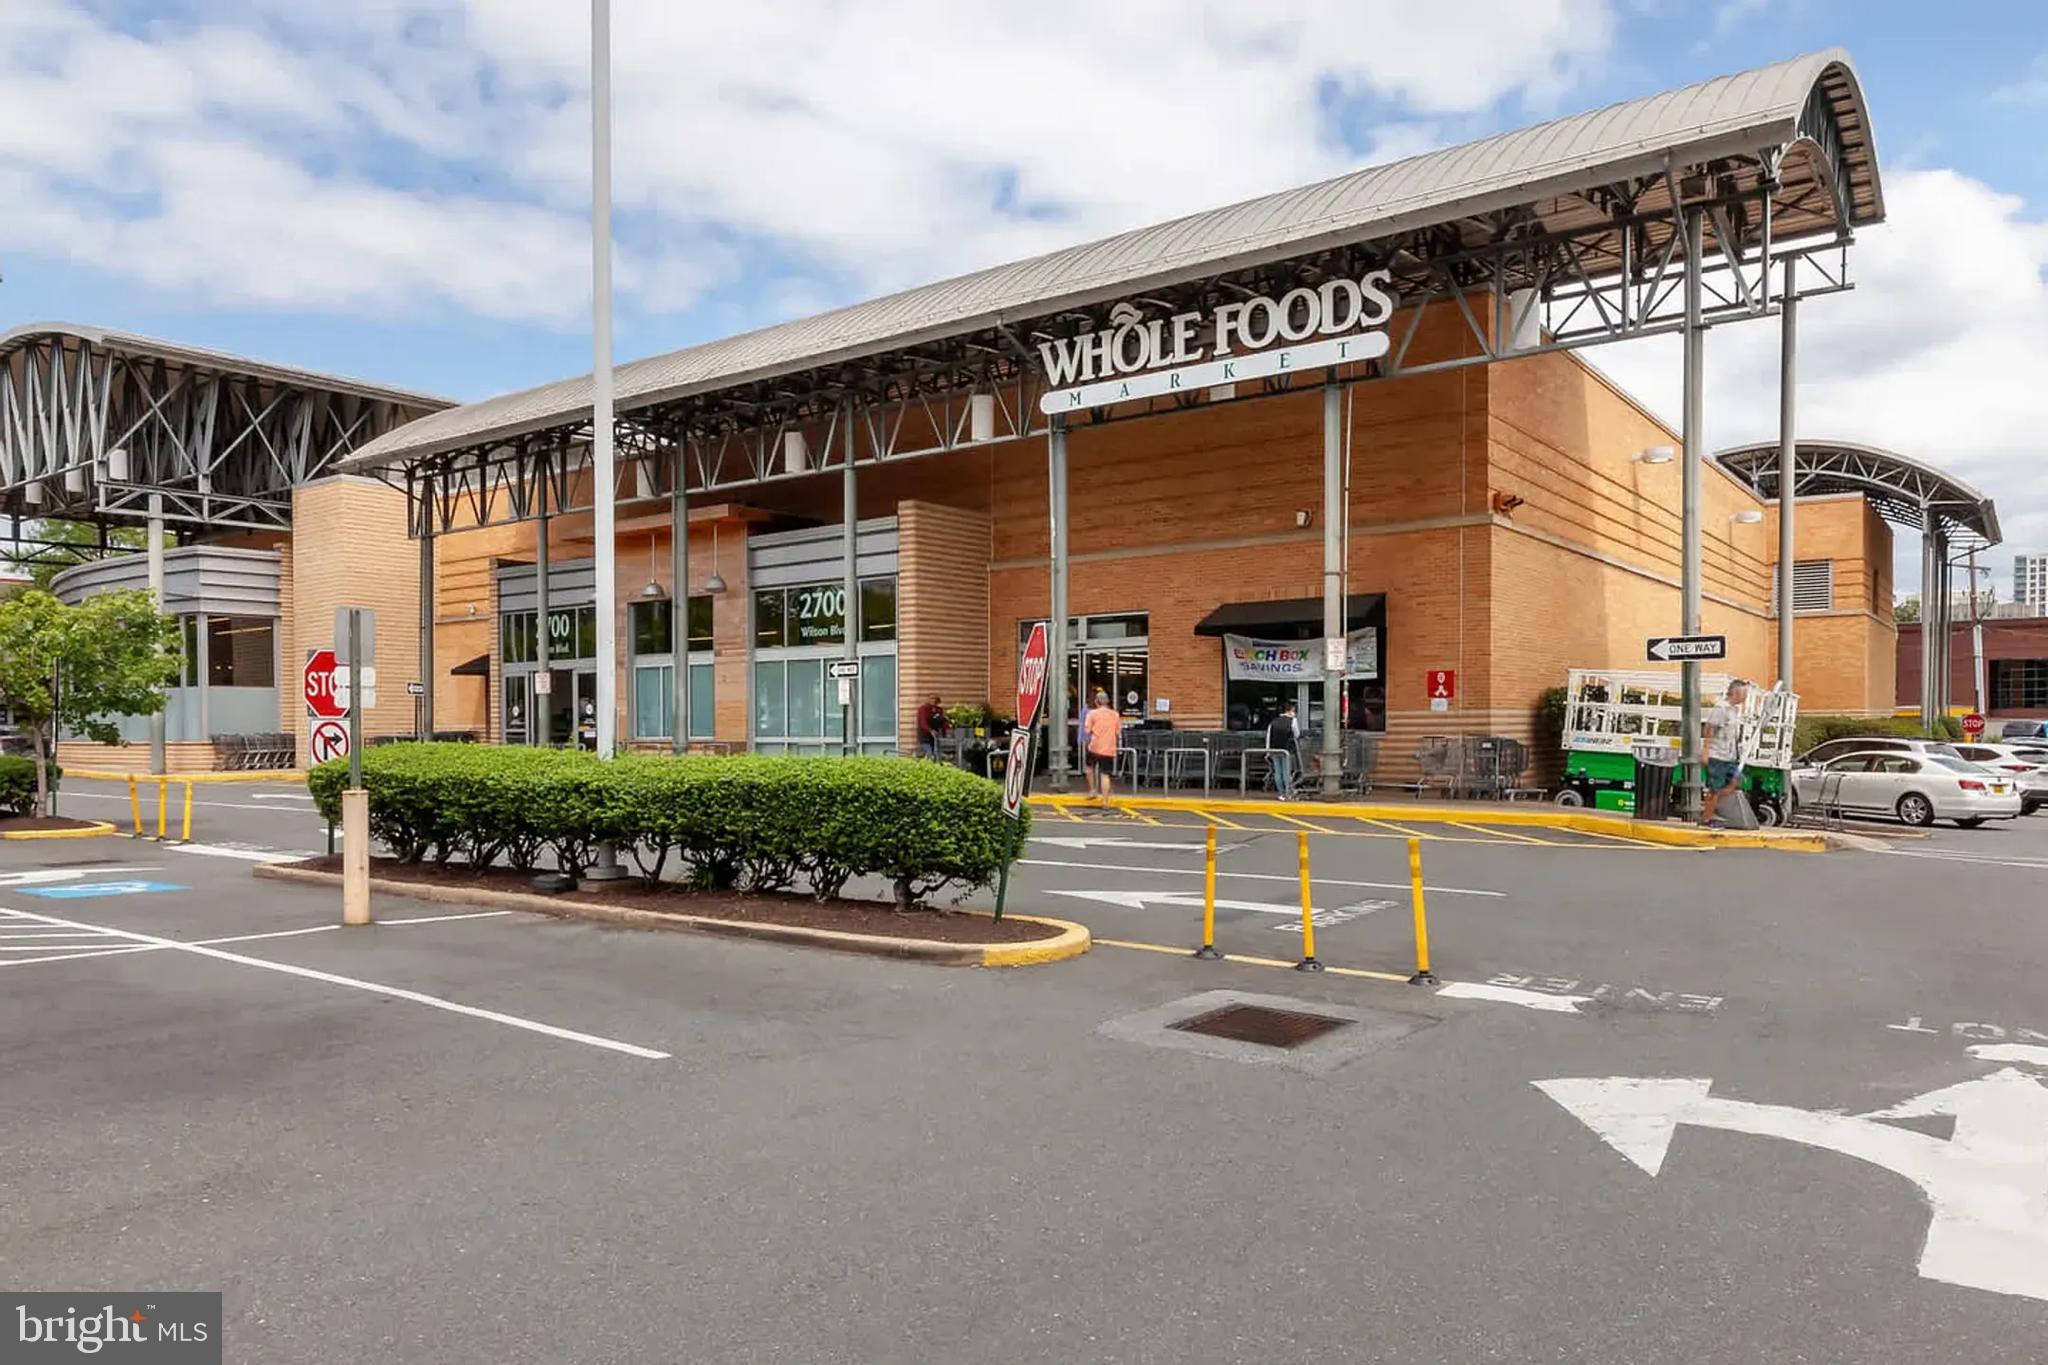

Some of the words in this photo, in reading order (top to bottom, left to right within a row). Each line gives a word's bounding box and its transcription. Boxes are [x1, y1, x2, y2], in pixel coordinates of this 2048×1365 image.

[1037, 303, 1203, 386] WHOLE
[1213, 269, 1393, 356] FOODS
[1069, 341, 1350, 406] MARKET
[800, 590, 846, 618] 2700
[801, 626, 828, 637] Wilson
[1280, 649, 1309, 661] BOX
[1669, 643, 1692, 654] ONE
[1694, 642, 1717, 652] WAY
[1019, 657, 1044, 696] STOP
[1963, 719, 1982, 729] STOP
